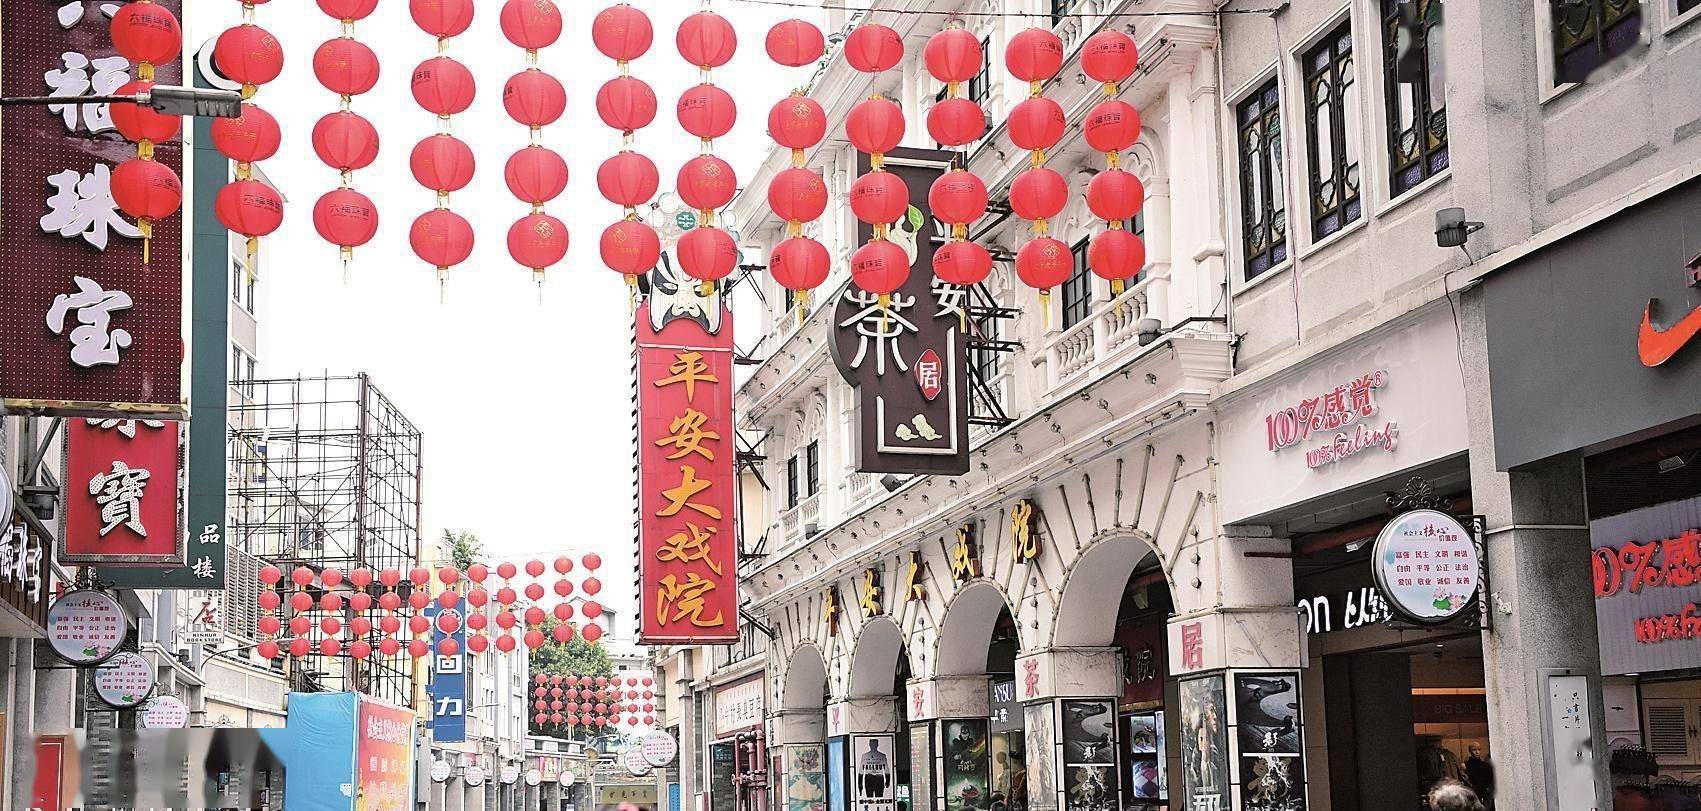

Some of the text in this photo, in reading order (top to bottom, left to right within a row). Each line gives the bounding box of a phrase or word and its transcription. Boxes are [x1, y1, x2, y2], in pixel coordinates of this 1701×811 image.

[918, 360, 939, 390] 居
[652, 350, 724, 629] 平安大戏院
[1396, 564, 1411, 573] 自由
[1416, 564, 1430, 572] 平等
[1435, 564, 1450, 572] 公正
[1397, 578, 1412, 586] 爱国
[1181, 621, 1204, 670] 居
